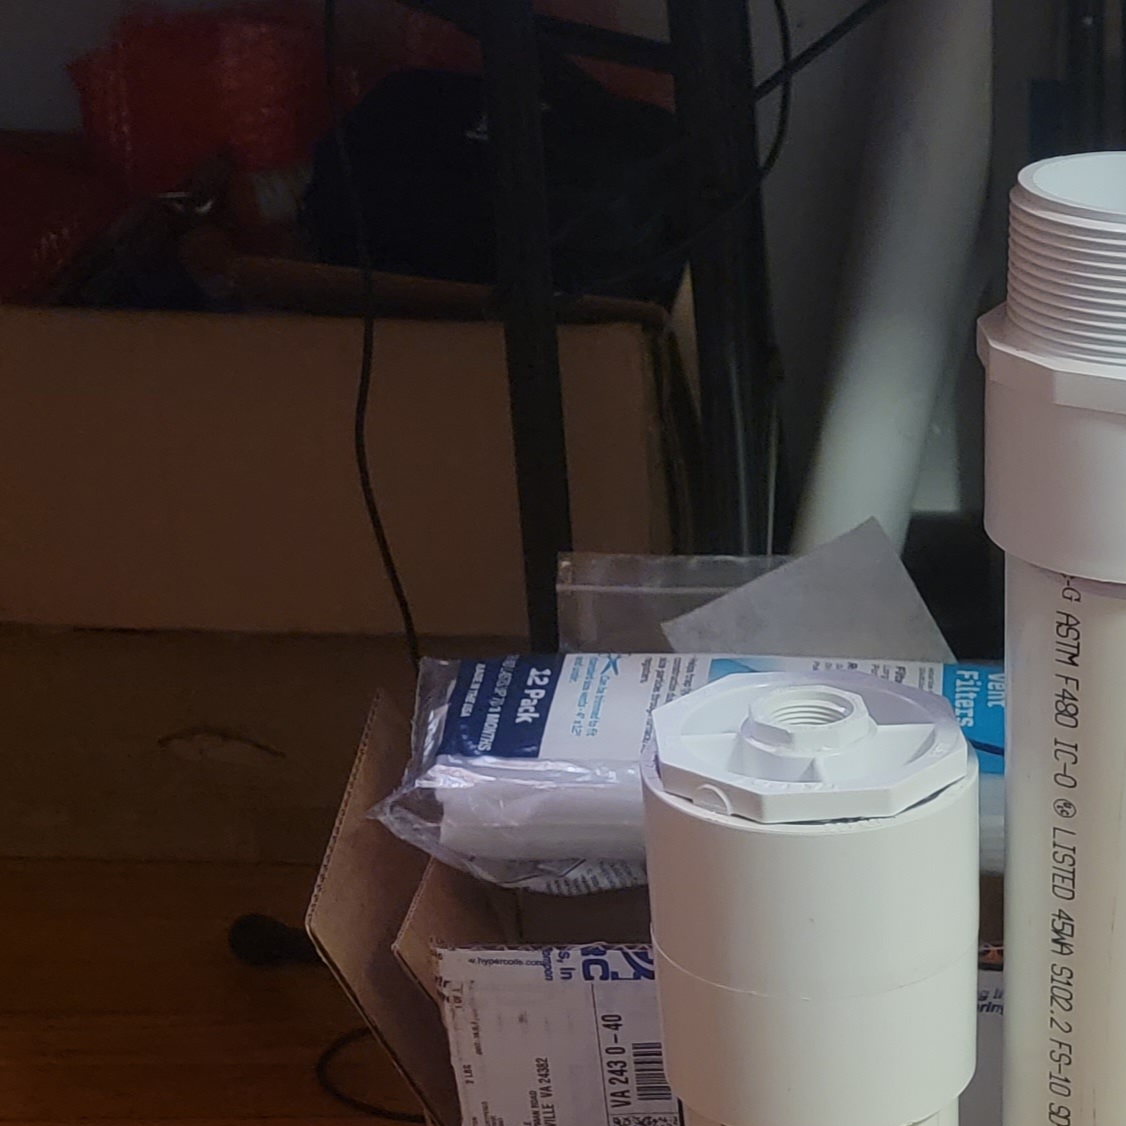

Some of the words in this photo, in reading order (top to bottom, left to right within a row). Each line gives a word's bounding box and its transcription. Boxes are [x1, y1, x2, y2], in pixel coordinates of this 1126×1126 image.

[1055, 611, 1081, 667] ASTM
[527, 667, 551, 686] 12
[515, 689, 546, 723] Pack
[955, 670, 982, 727] Filters
[1054, 674, 1079, 728] F480
[477, 713, 500, 751] MONTHS
[1052, 827, 1076, 901] LISTED
[535, 1058, 551, 1083] 24382
[607, 1060, 629, 1085] 243
[1049, 1038, 1072, 1098] FS-10
[540, 1085, 553, 1098] VA
[610, 1090, 632, 1108] VA
